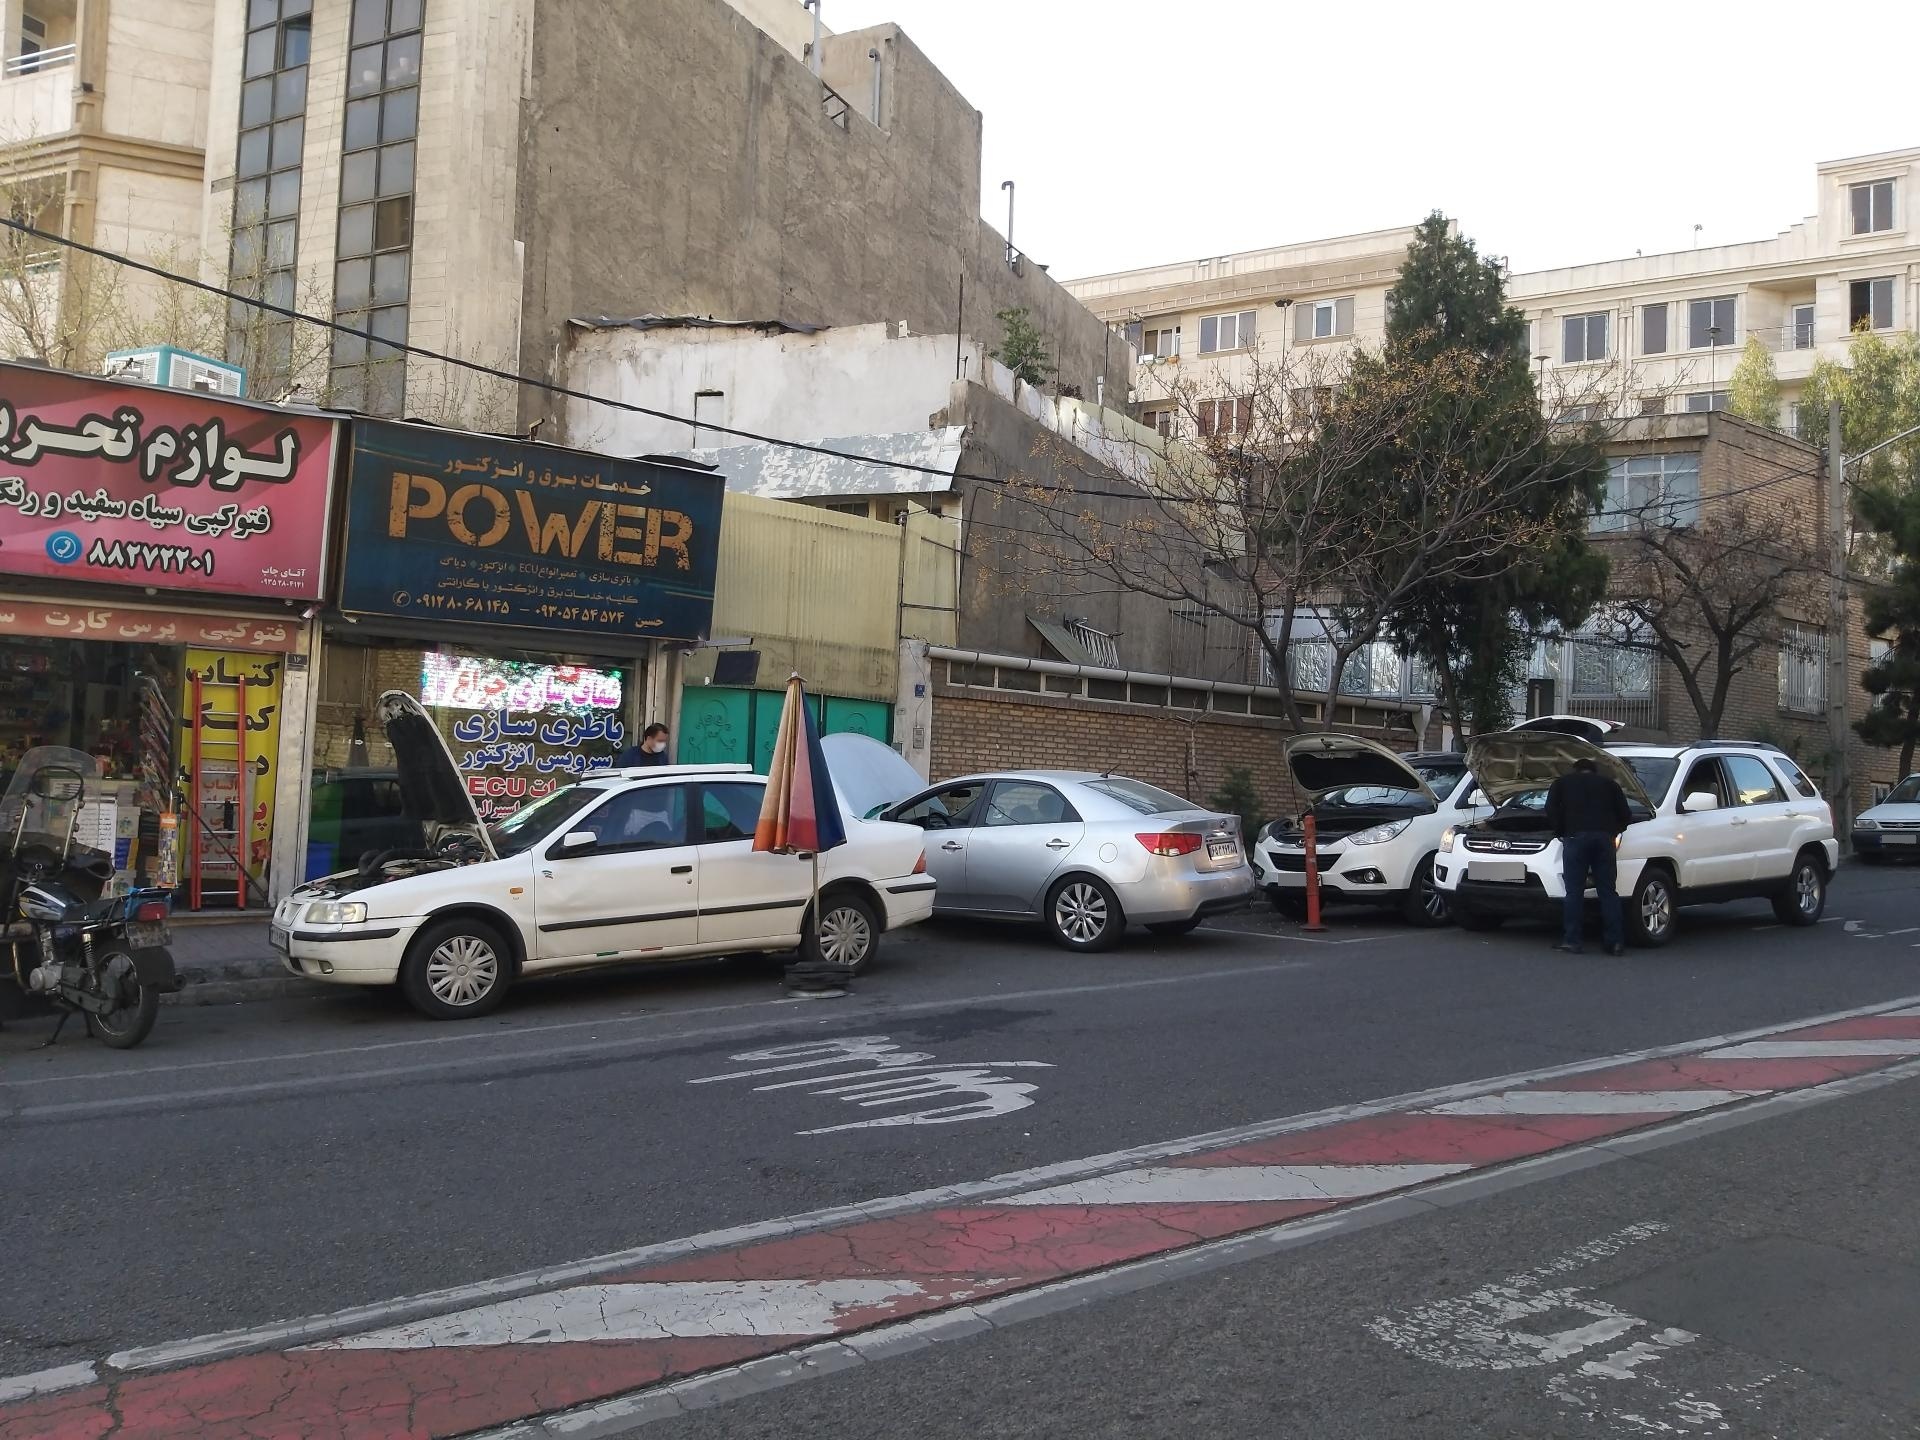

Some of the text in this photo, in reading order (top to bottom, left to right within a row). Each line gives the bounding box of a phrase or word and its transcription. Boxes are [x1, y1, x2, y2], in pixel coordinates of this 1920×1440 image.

[146, 422, 297, 487] لوازم
[442, 456, 652, 497] خدمات برق و انژکتور
[44, 491, 61, 517] و
[65, 488, 125, 520] سفید
[130, 494, 182, 528] سیاه
[187, 504, 272, 539] فتوکپی
[388, 472, 694, 571] POWER
[519, 563, 539, 574] ECU
[45, 610, 286, 646] فتوکپی پرس کارت
[454, 708, 625, 749] باطری سازی
[459, 743, 614, 774] سرویس انژکتور
[468, 776, 527, 798] ECU
